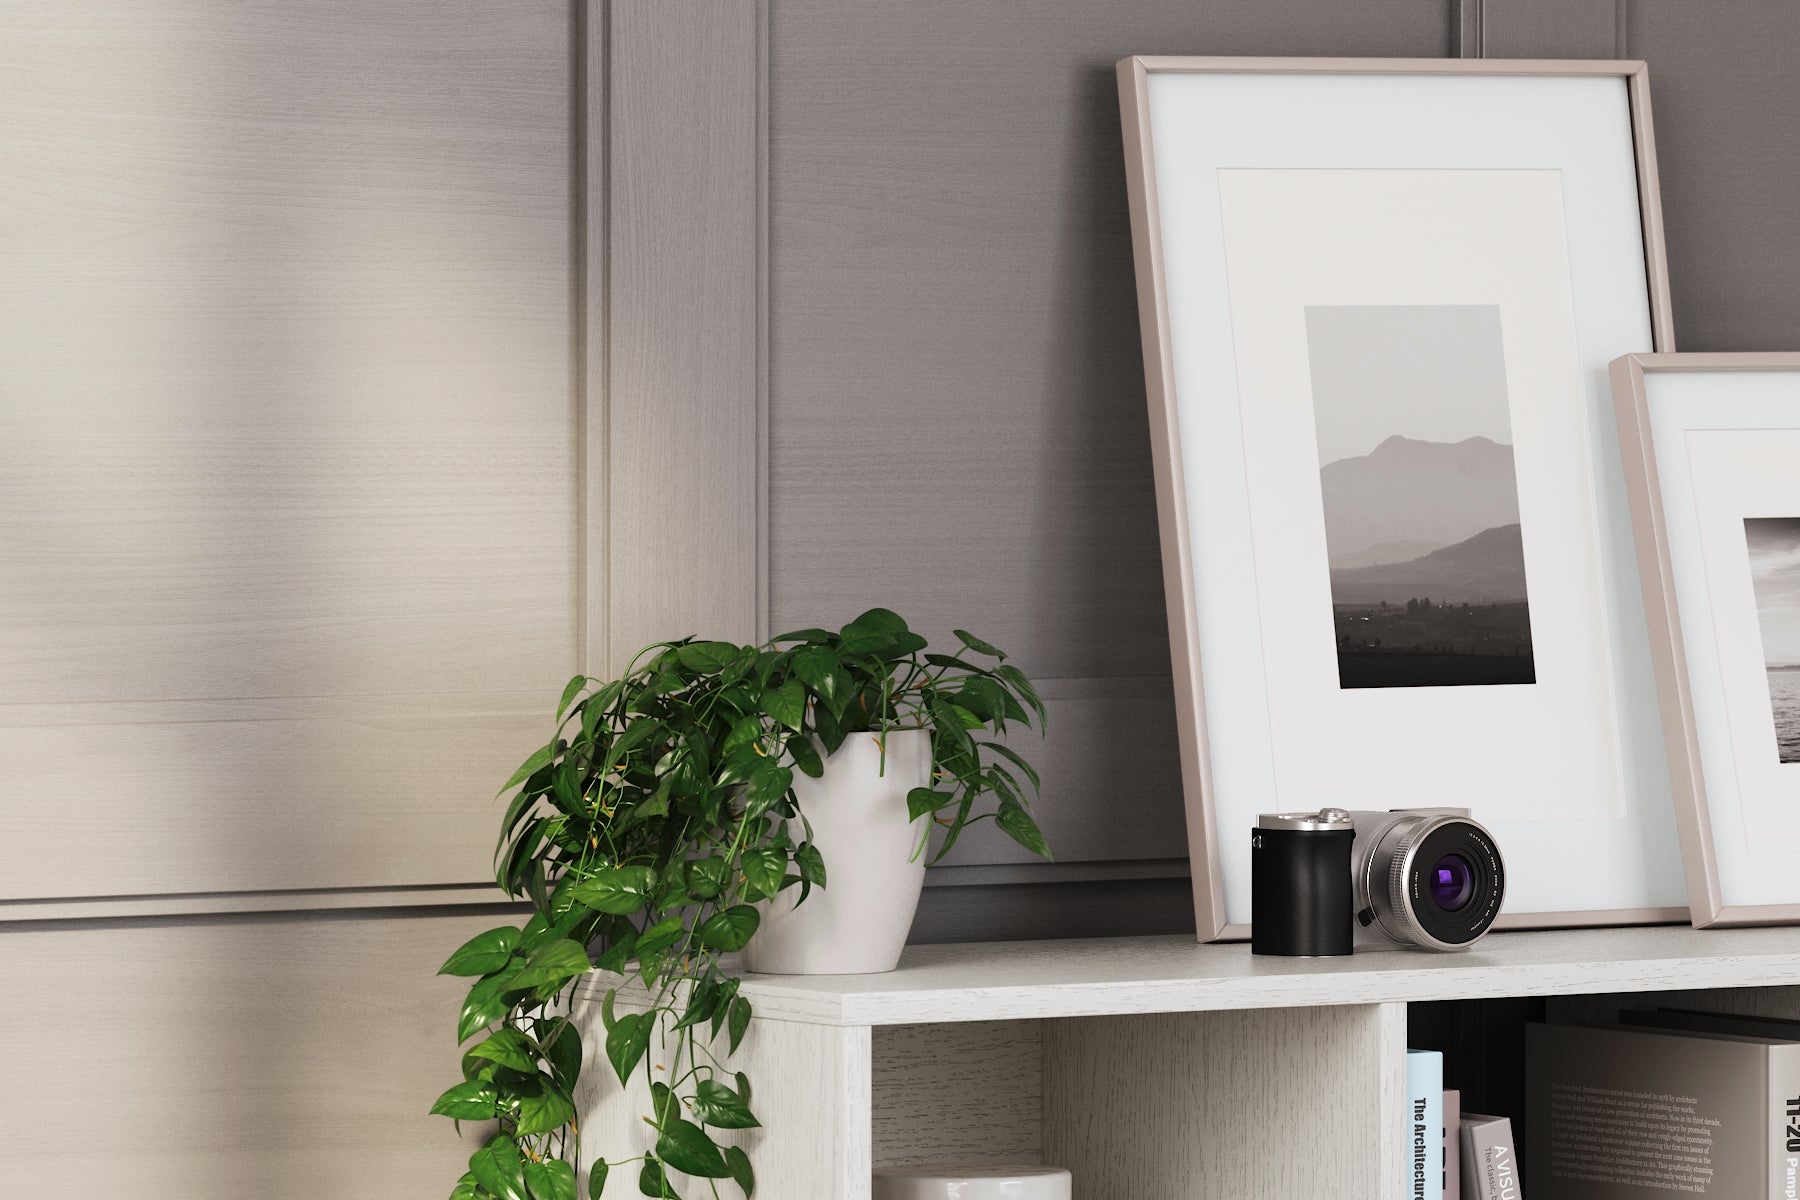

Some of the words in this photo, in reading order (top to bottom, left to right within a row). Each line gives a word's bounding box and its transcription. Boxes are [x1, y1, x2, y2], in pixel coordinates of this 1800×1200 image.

[1415, 1098, 1426, 1121] The
[1494, 1146, 1507, 1158] A
[1487, 1164, 1496, 1194] classic,
